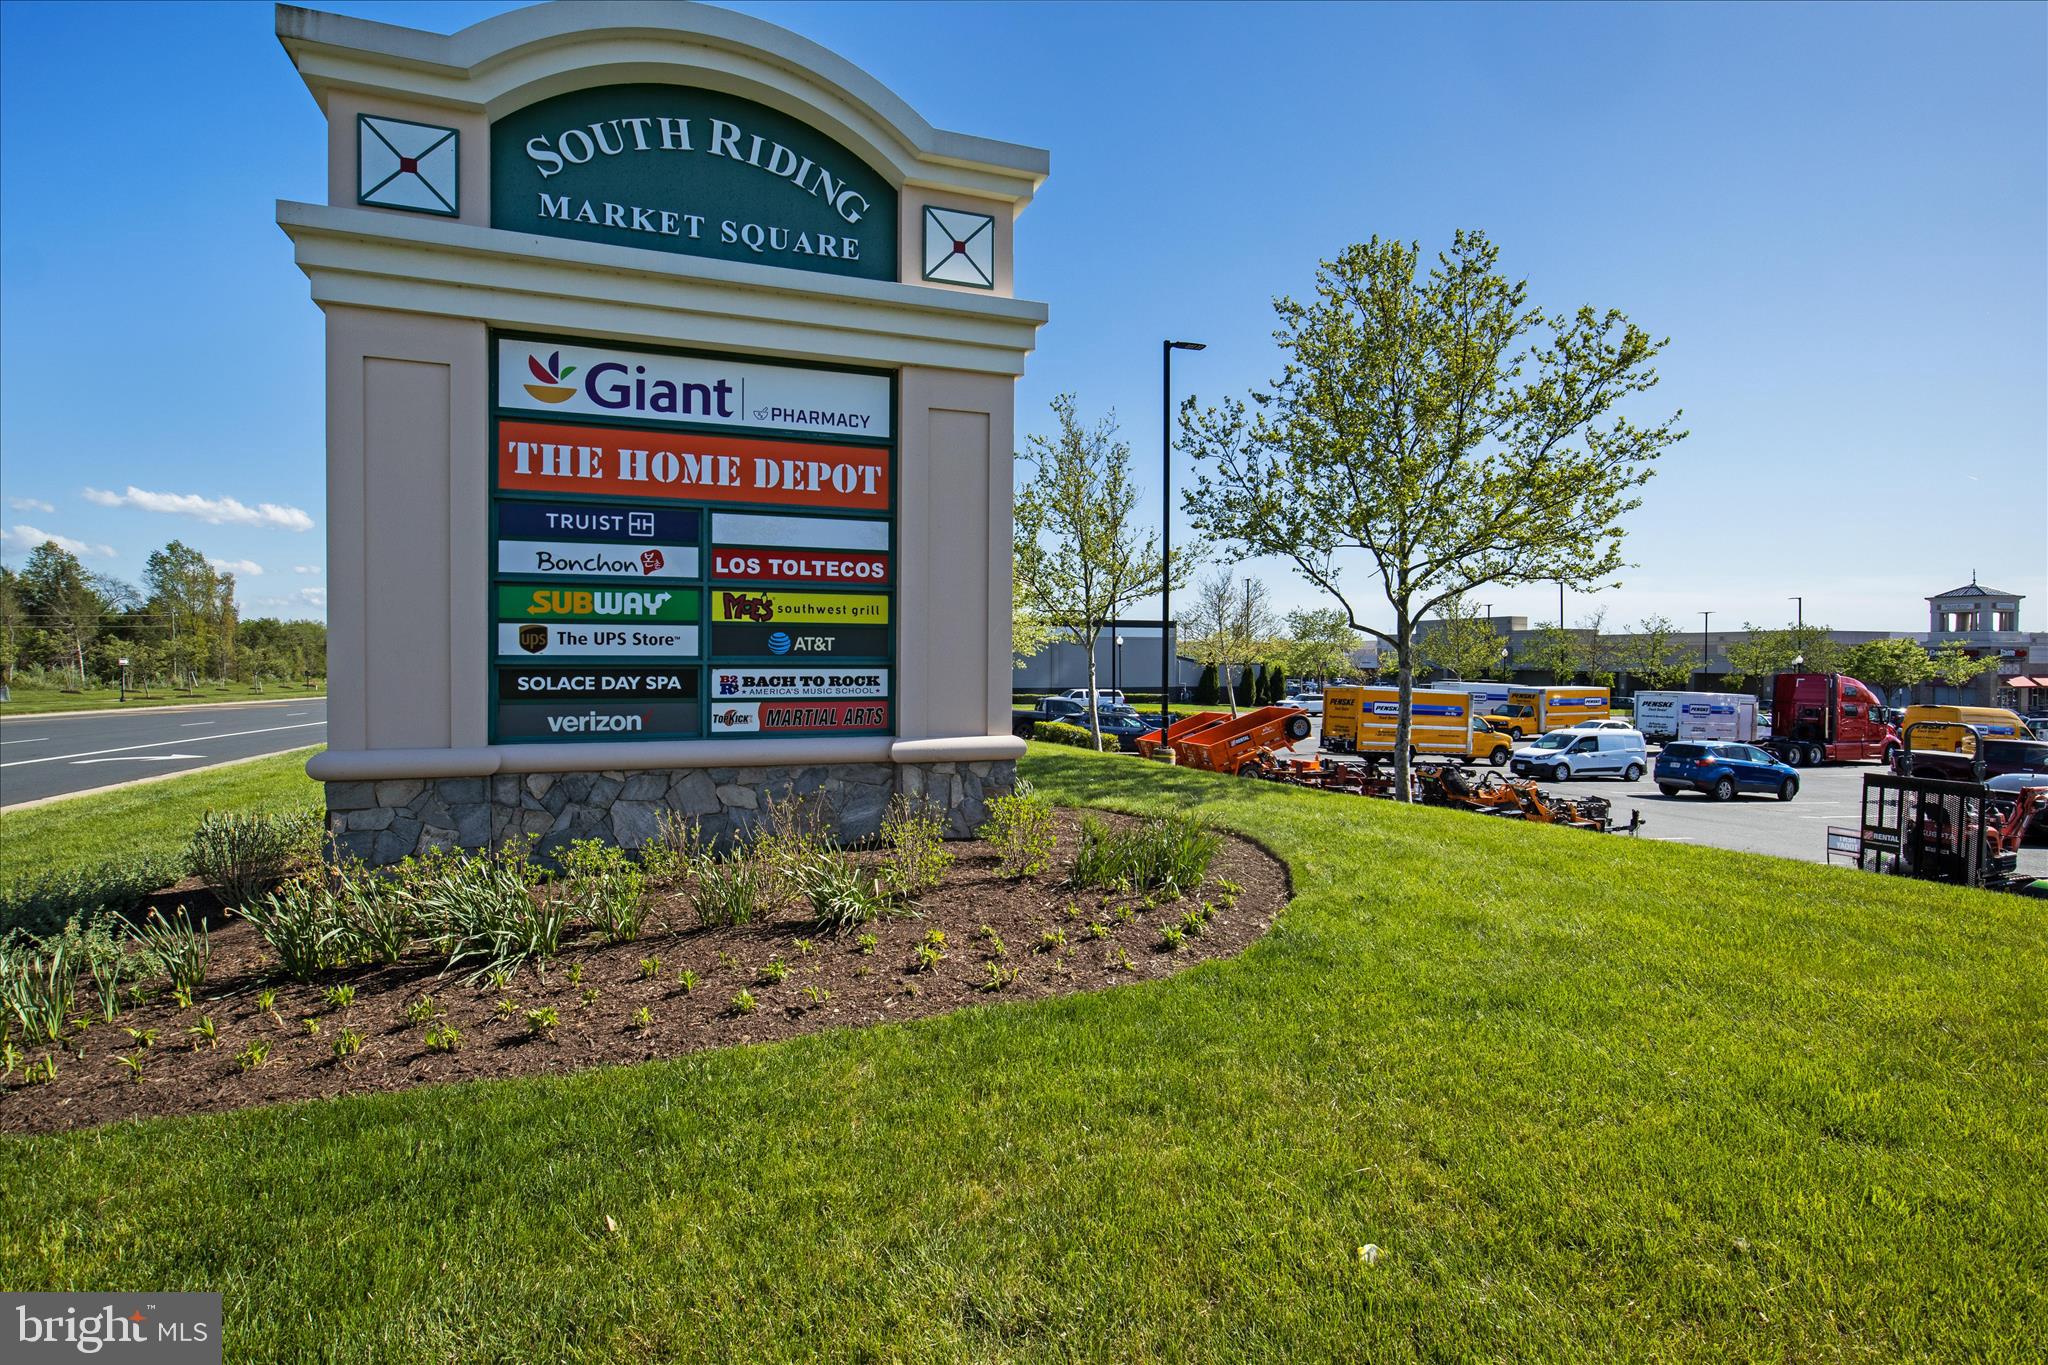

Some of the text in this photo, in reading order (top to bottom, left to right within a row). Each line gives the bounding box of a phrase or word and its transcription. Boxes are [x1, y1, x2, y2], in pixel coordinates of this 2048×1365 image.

[526, 116, 871, 225] SOUTH RIDING
[537, 192, 860, 261] MARKET SQUARE
[585, 361, 871, 429] Giant PHARMACY
[508, 441, 882, 495] THE HOME DEPOT
[546, 513, 623, 531] TRUIST
[535, 551, 638, 573] Bonchon
[715, 556, 885, 578] LOS TOLTECOS
[527, 590, 672, 615] SUBWAY
[777, 603, 847, 615] southwest
[851, 604, 880, 617] grill
[521, 633, 547, 650] ups
[557, 631, 588, 646] The
[594, 631, 626, 646] UPS
[794, 637, 835, 651] AT&T
[517, 676, 682, 690] SOLACE DAY SPA
[741, 675, 881, 687] BACH TO ROCK
[1329, 698, 1356, 706] PENSKE
[547, 711, 642, 732] verizon
[765, 708, 837, 727] MARTIAL
[841, 707, 884, 726] ARTS
[1873, 832, 1900, 843] RENTAL
